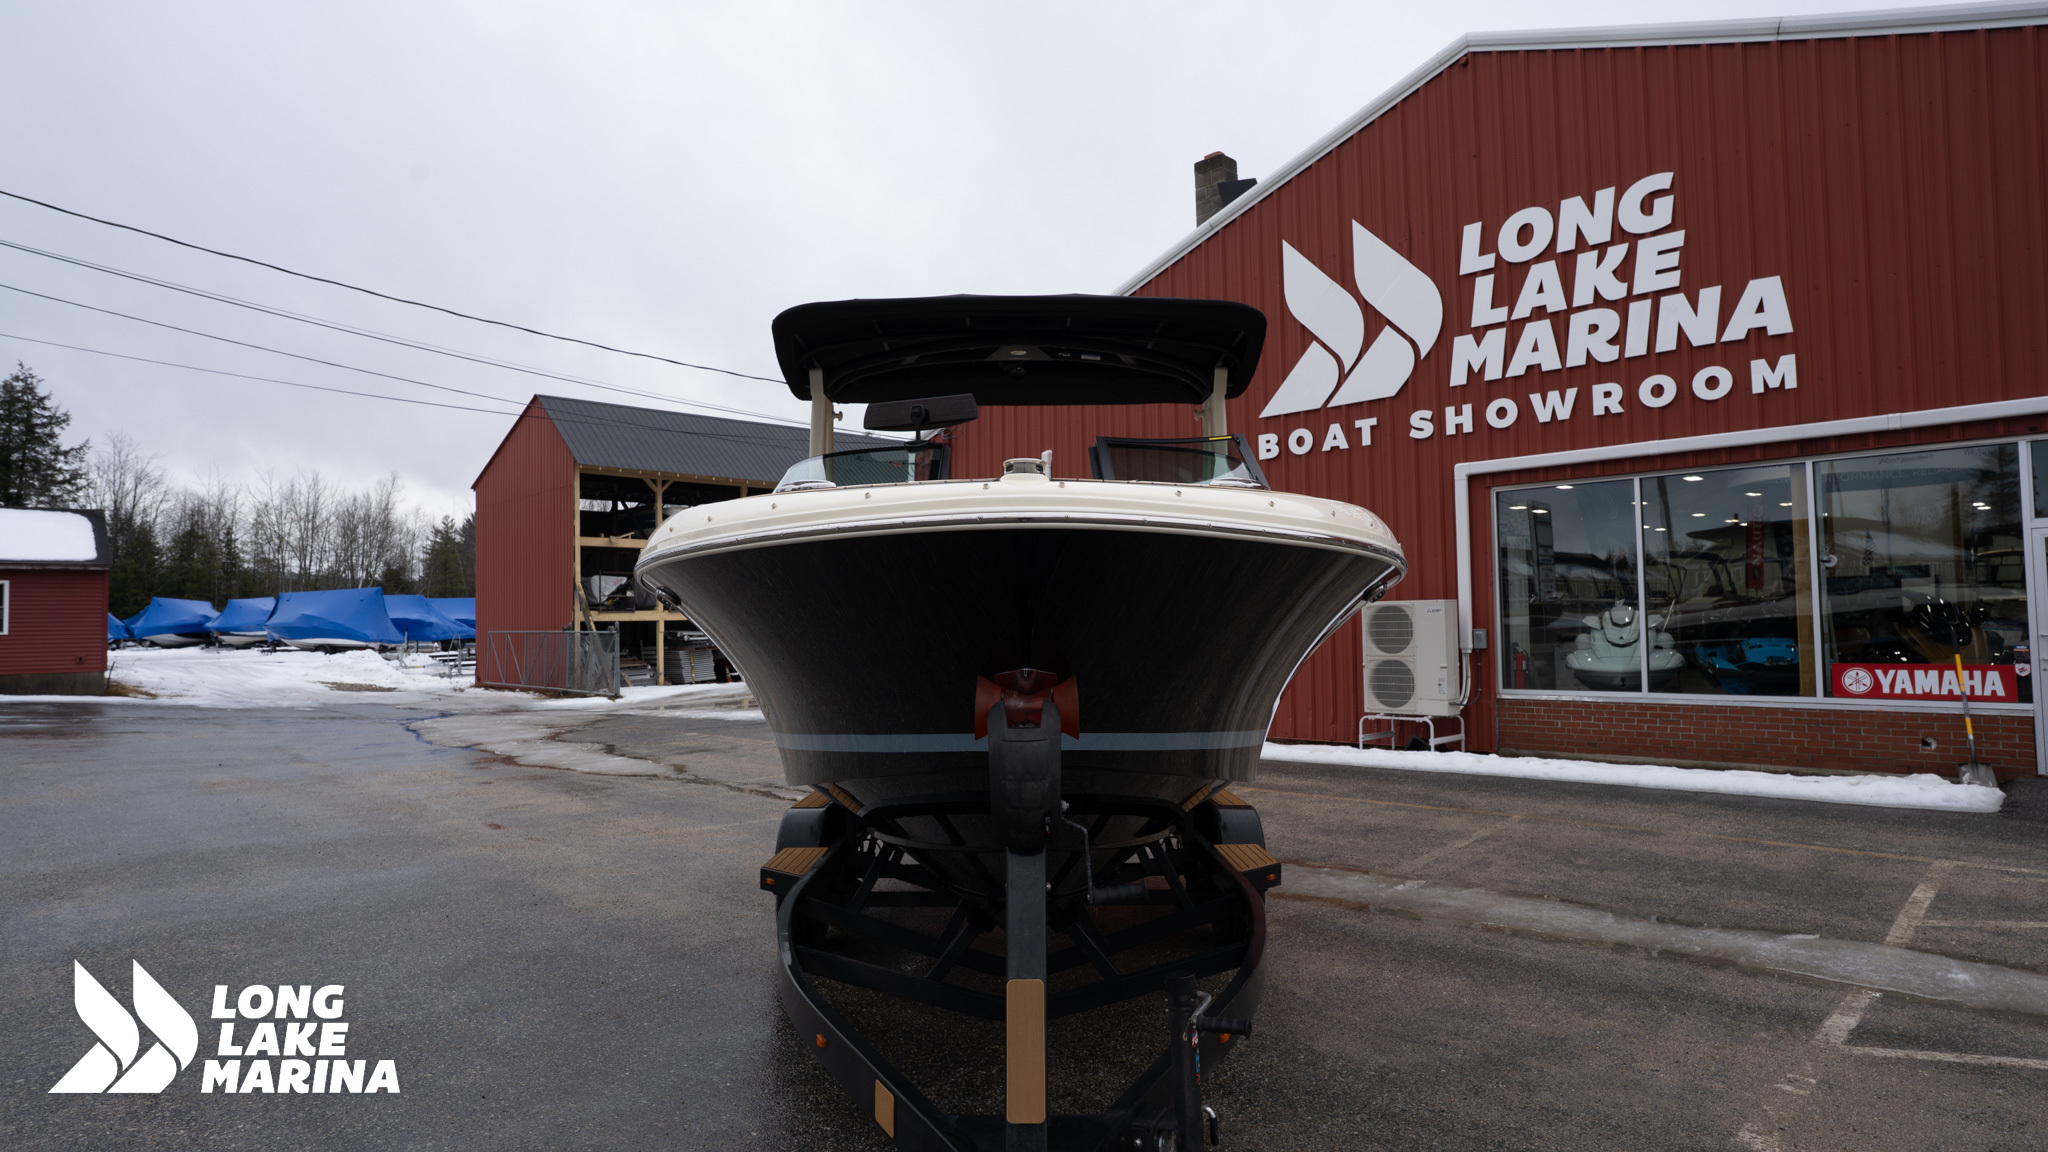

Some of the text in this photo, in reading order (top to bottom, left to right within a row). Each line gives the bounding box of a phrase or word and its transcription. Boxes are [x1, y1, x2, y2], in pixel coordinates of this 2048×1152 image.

[1459, 171, 1675, 276] LONG
[1449, 275, 1794, 387] MARINA
[1470, 229, 1686, 328] LAKE
[1258, 354, 1798, 460] BOAT SHOWROOM
[1875, 670, 2006, 697] YAMAHA
